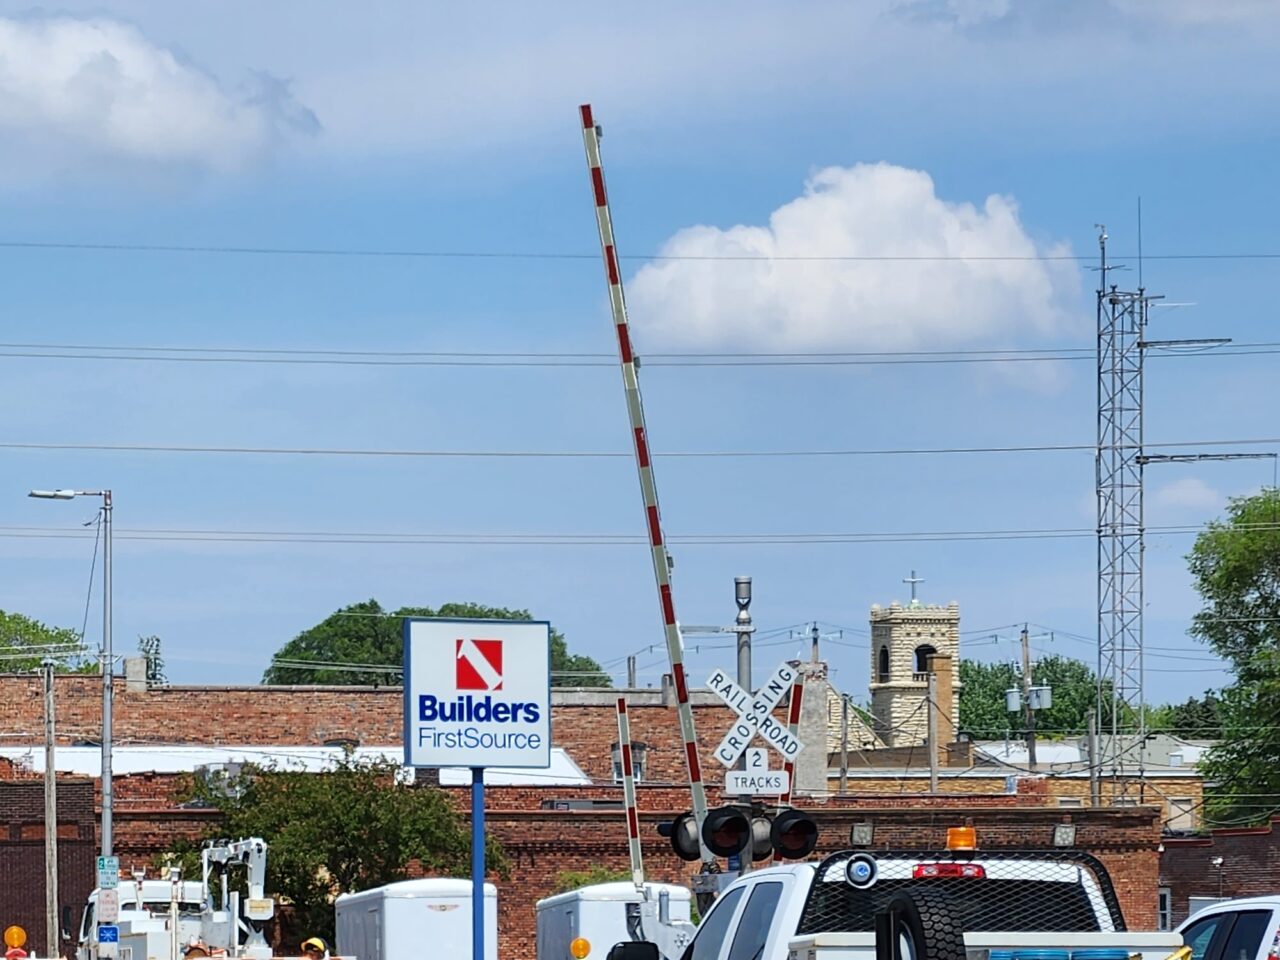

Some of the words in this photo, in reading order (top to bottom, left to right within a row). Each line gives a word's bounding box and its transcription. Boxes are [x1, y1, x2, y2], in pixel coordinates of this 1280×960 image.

[418, 694, 540, 723] Builders
[720, 668, 792, 762] CROSSING
[418, 727, 541, 749] FirstSource
[752, 752, 762, 767] 2
[734, 777, 781, 788] TRACKS
